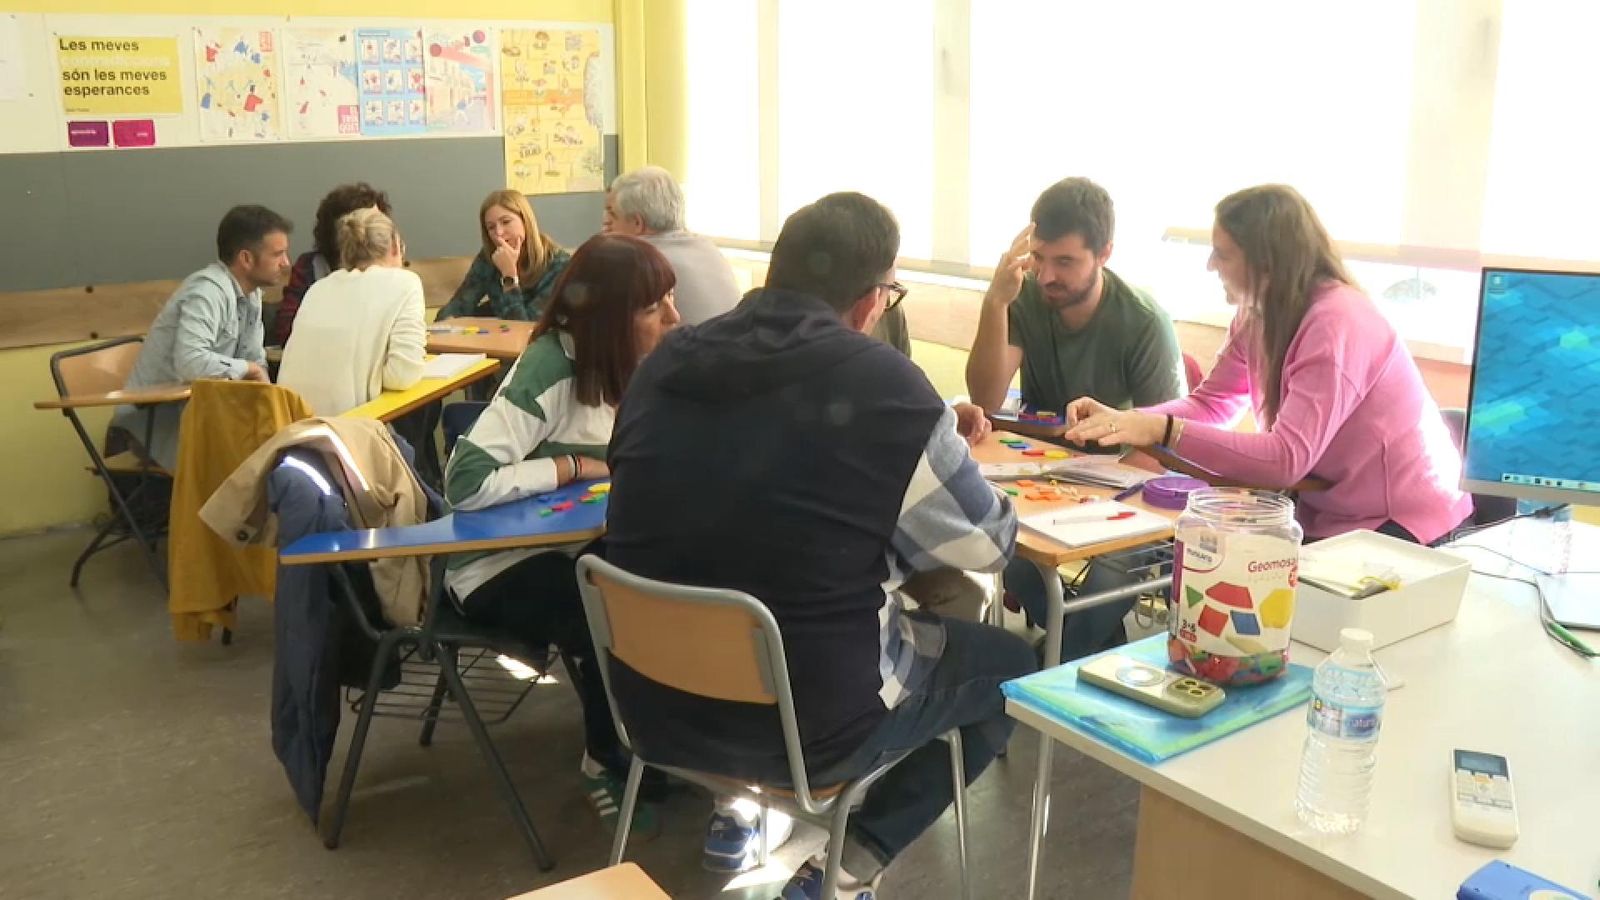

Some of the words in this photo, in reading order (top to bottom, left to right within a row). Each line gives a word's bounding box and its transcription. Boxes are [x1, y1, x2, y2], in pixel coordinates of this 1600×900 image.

[59, 39, 87, 50] Les
[91, 41, 139, 50] meves
[62, 69, 90, 80] són
[94, 68, 116, 80] les
[120, 71, 167, 80] meves
[64, 86, 149, 97] esperances
